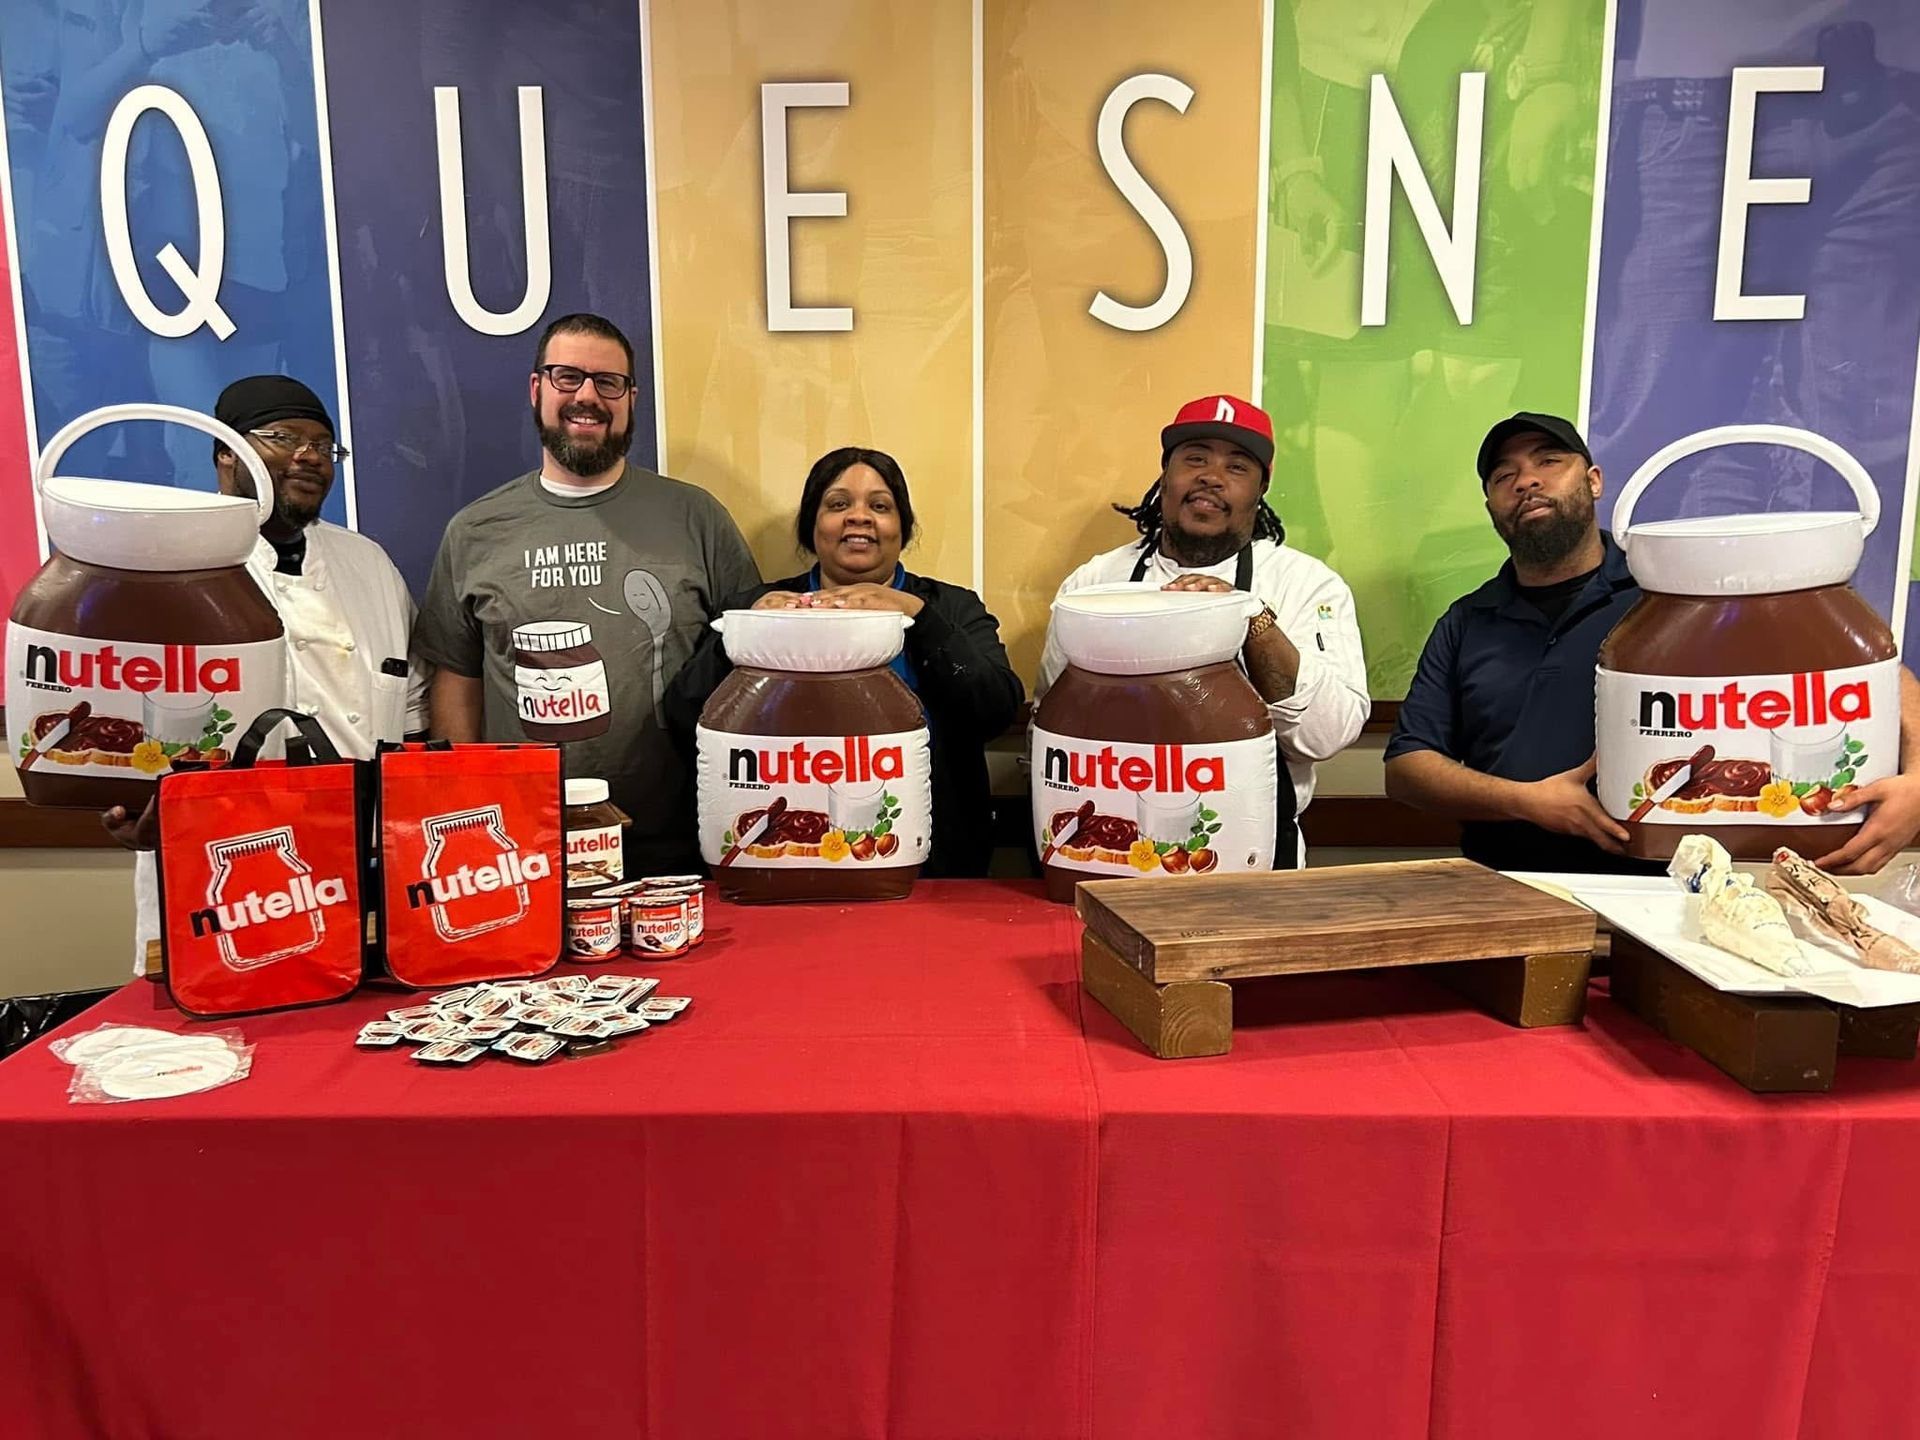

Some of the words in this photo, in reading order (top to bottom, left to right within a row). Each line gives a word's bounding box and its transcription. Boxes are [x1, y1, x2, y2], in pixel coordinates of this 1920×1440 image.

[524, 549, 531, 569] I
[534, 545, 560, 567] AM
[564, 541, 608, 563] HERE
[531, 567, 565, 588] FOR
[569, 564, 602, 586] YOU
[25, 644, 241, 694] nutella
[25, 680, 72, 694] FERRERO
[522, 688, 601, 718] nutella
[1639, 671, 1872, 731] nutella
[1638, 728, 1693, 738] FERRERO
[729, 735, 904, 785] nutella
[1044, 743, 1226, 793] nutella
[729, 781, 771, 791] FERRERO
[1044, 780, 1080, 793] FERRERO
[567, 832, 620, 855] utella
[405, 850, 552, 909] nutella
[189, 874, 348, 938] nutella
[568, 924, 611, 938] nutella
[637, 921, 681, 934] nutella
